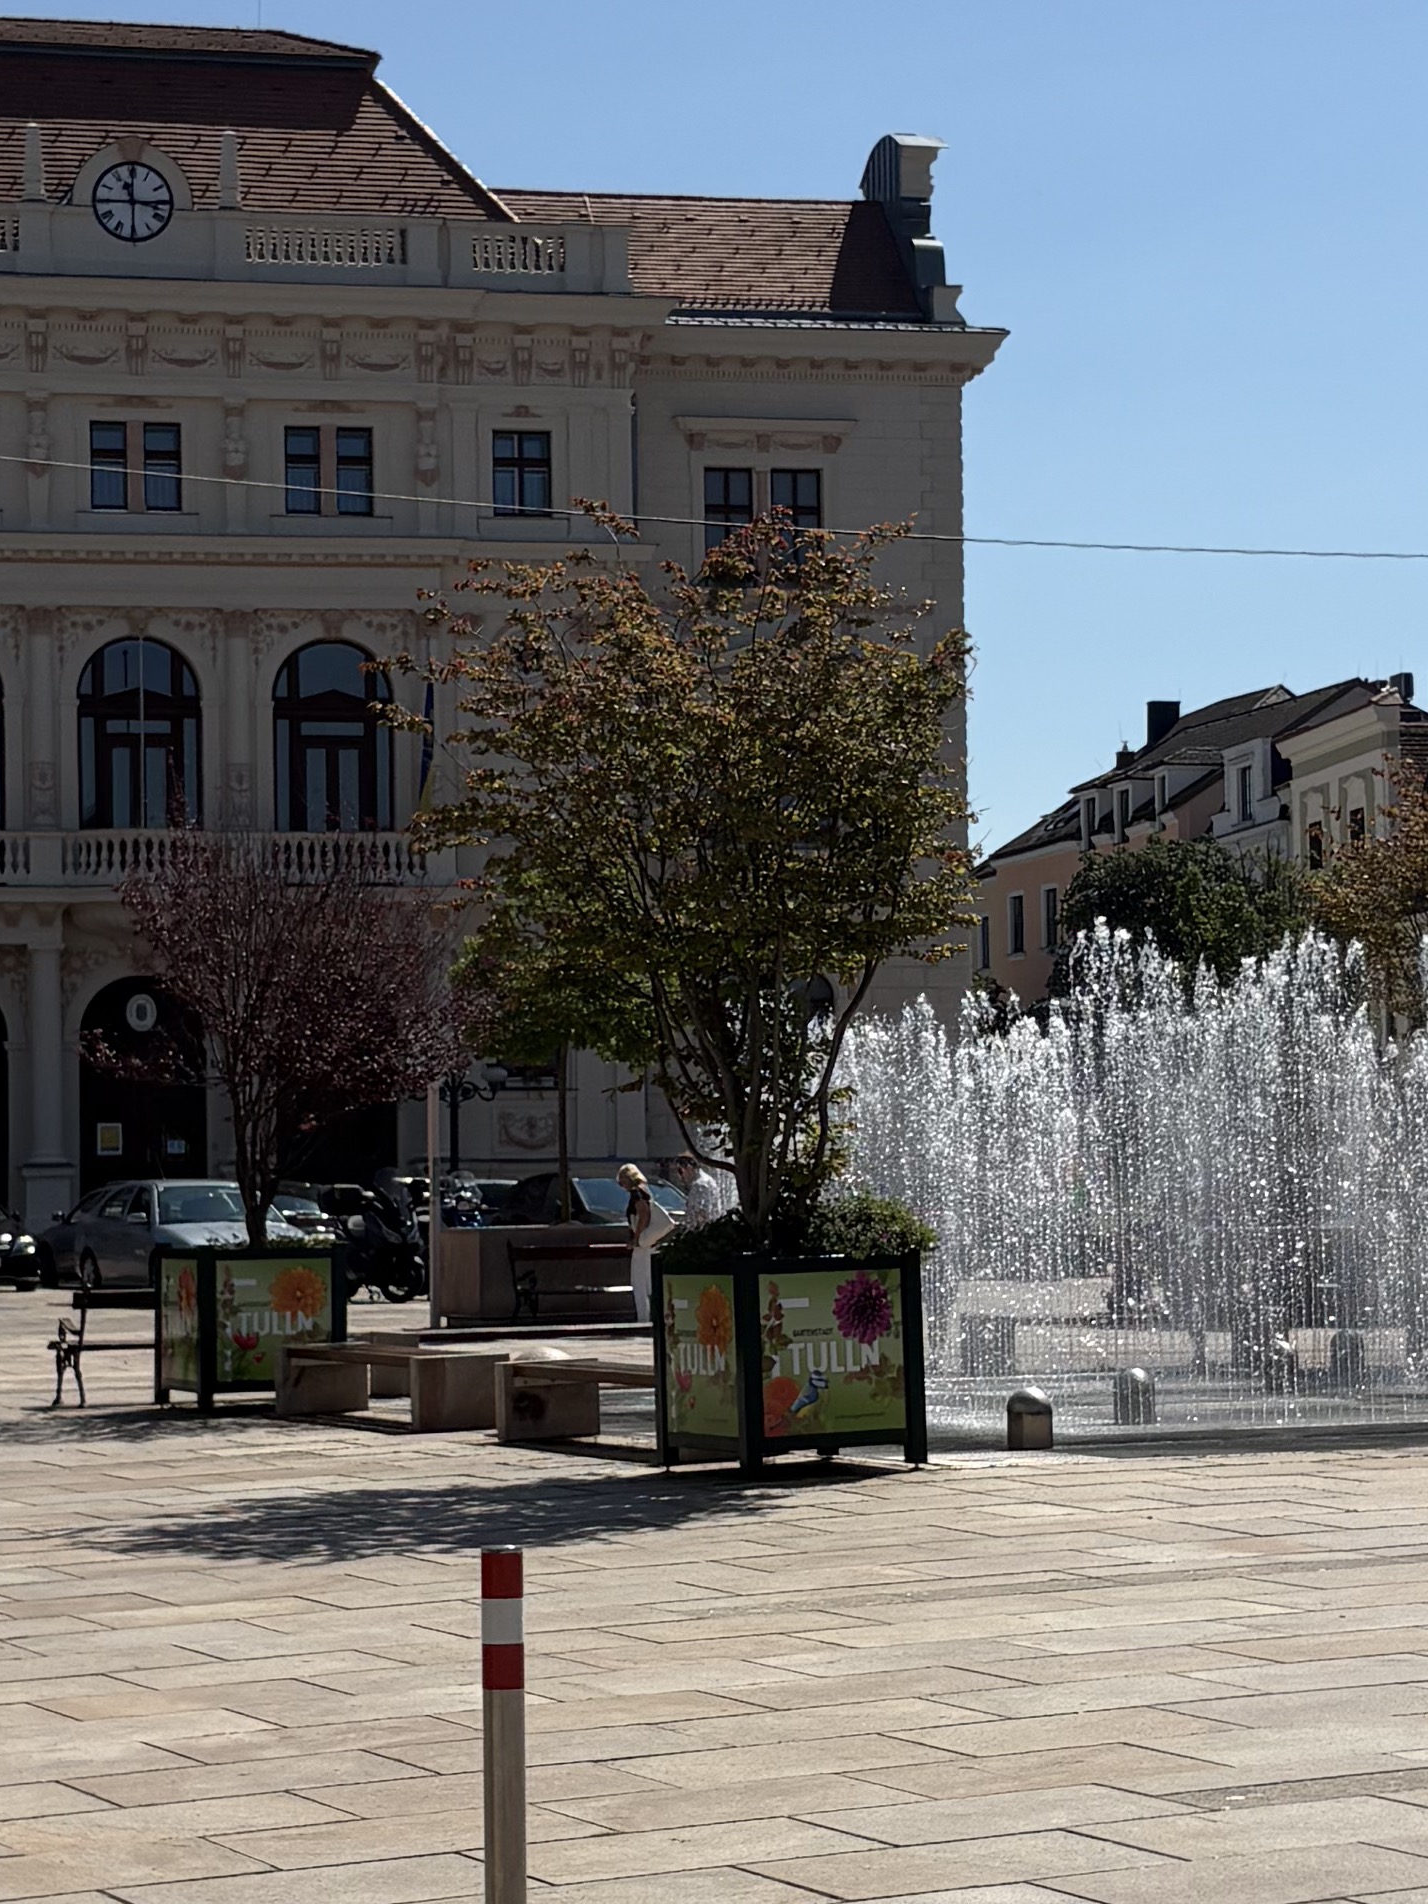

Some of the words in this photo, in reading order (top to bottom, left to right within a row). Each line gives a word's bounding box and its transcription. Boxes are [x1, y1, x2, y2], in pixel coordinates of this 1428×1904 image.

[237, 1310, 313, 1336] TULLN
[677, 1342, 726, 1376] TULLN
[787, 1340, 880, 1375] TULLN
